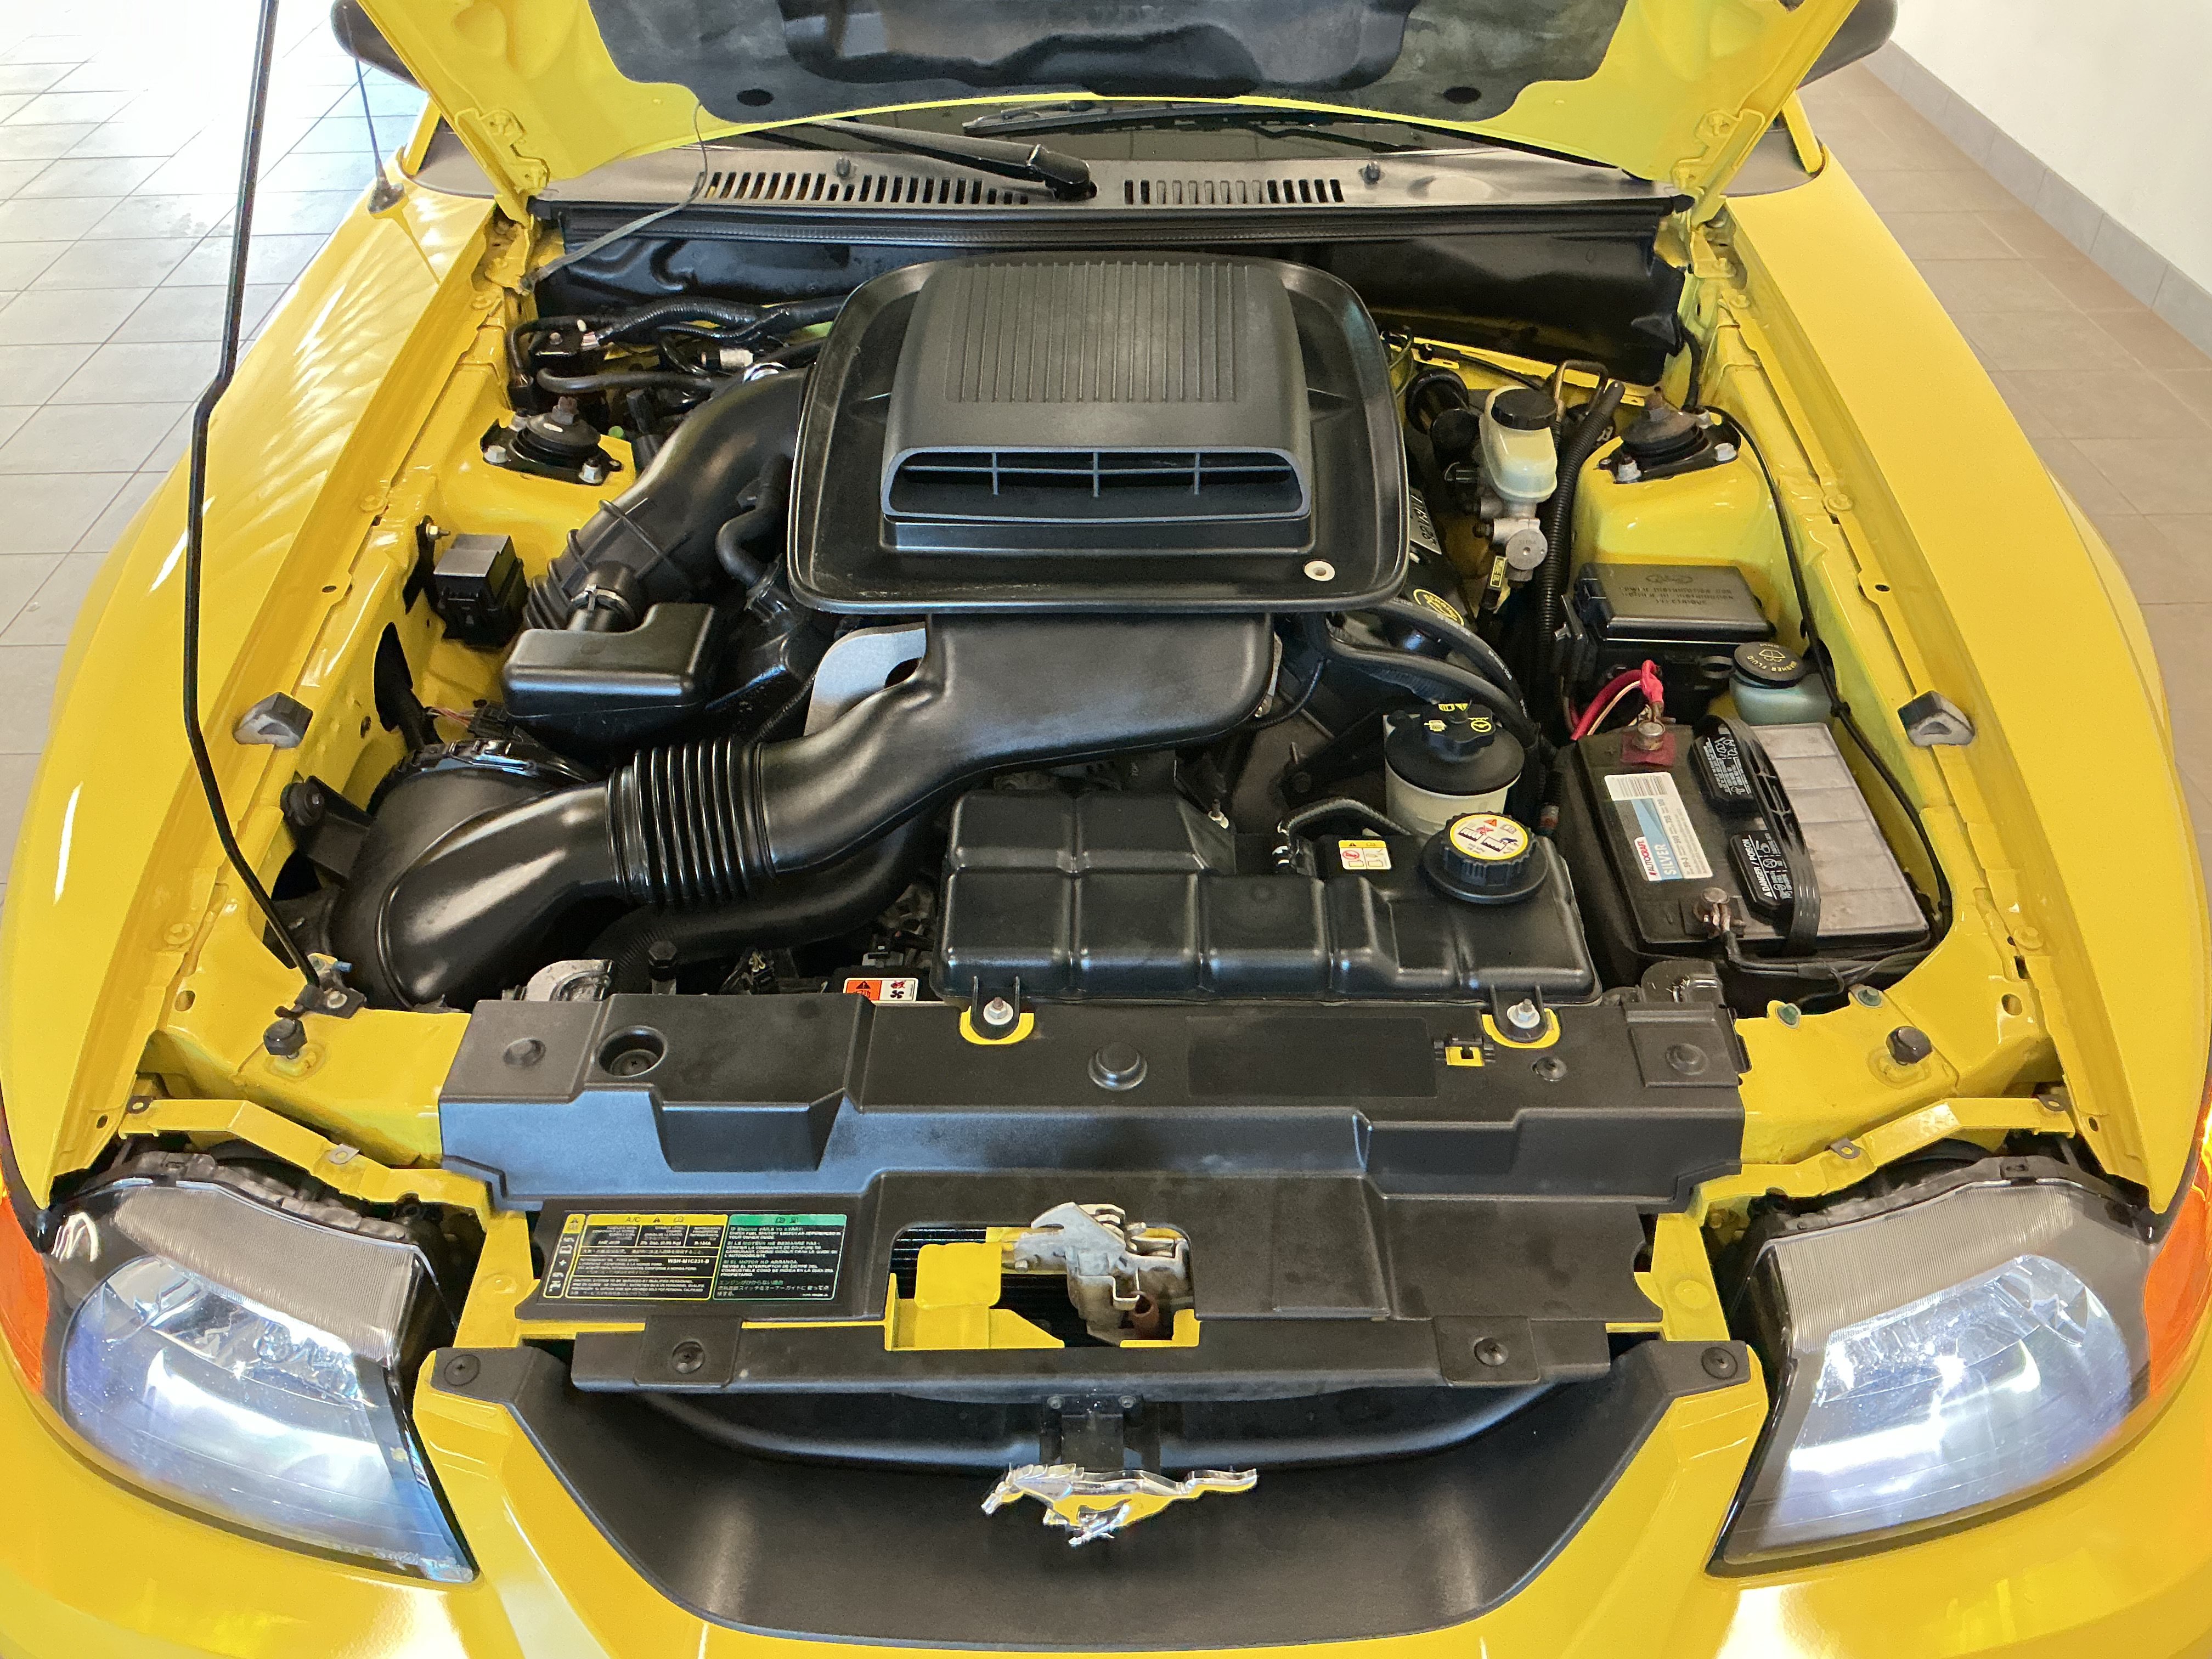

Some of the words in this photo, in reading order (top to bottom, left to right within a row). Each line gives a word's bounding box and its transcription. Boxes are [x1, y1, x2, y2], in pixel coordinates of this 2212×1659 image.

[1747, 655, 1767, 670] FLUID
[1637, 841, 1654, 872] AUTOCRAFT
[1654, 843, 1677, 876] SILVER
[1742, 839, 1757, 861] POISON
[1753, 866, 1770, 891] DANGER
